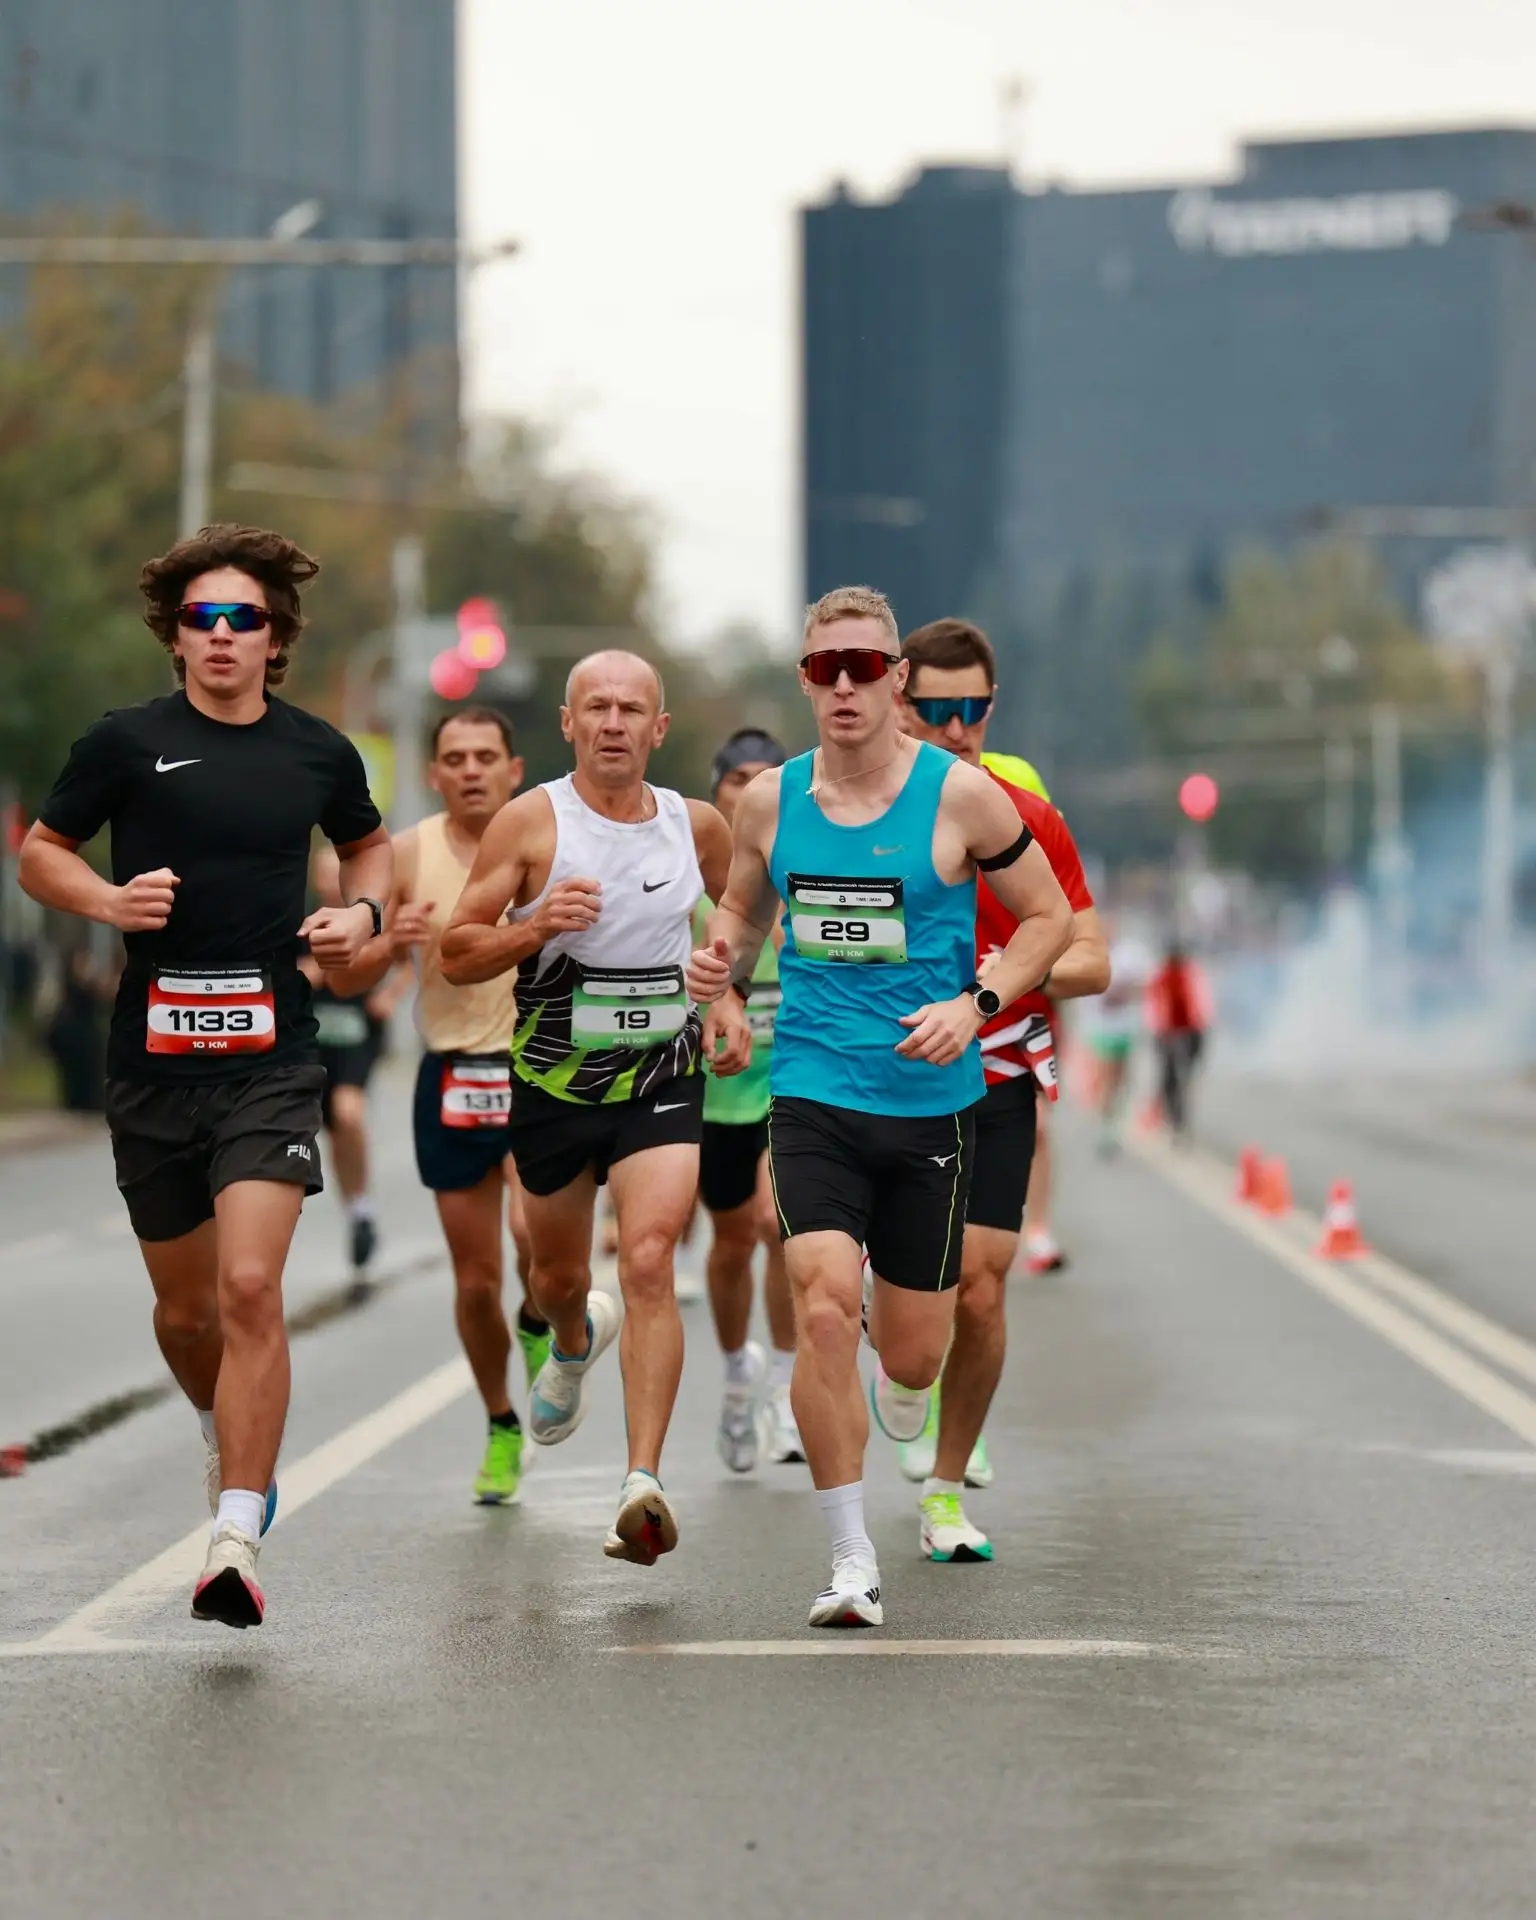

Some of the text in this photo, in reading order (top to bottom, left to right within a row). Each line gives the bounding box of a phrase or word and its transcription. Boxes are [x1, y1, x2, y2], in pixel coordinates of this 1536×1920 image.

[820, 920, 870, 942] 29
[168, 1009, 253, 1031] 1133
[613, 1010, 650, 1030] 19
[192, 1041, 227, 1049] 10 KM
[464, 1094, 512, 1109] 131
